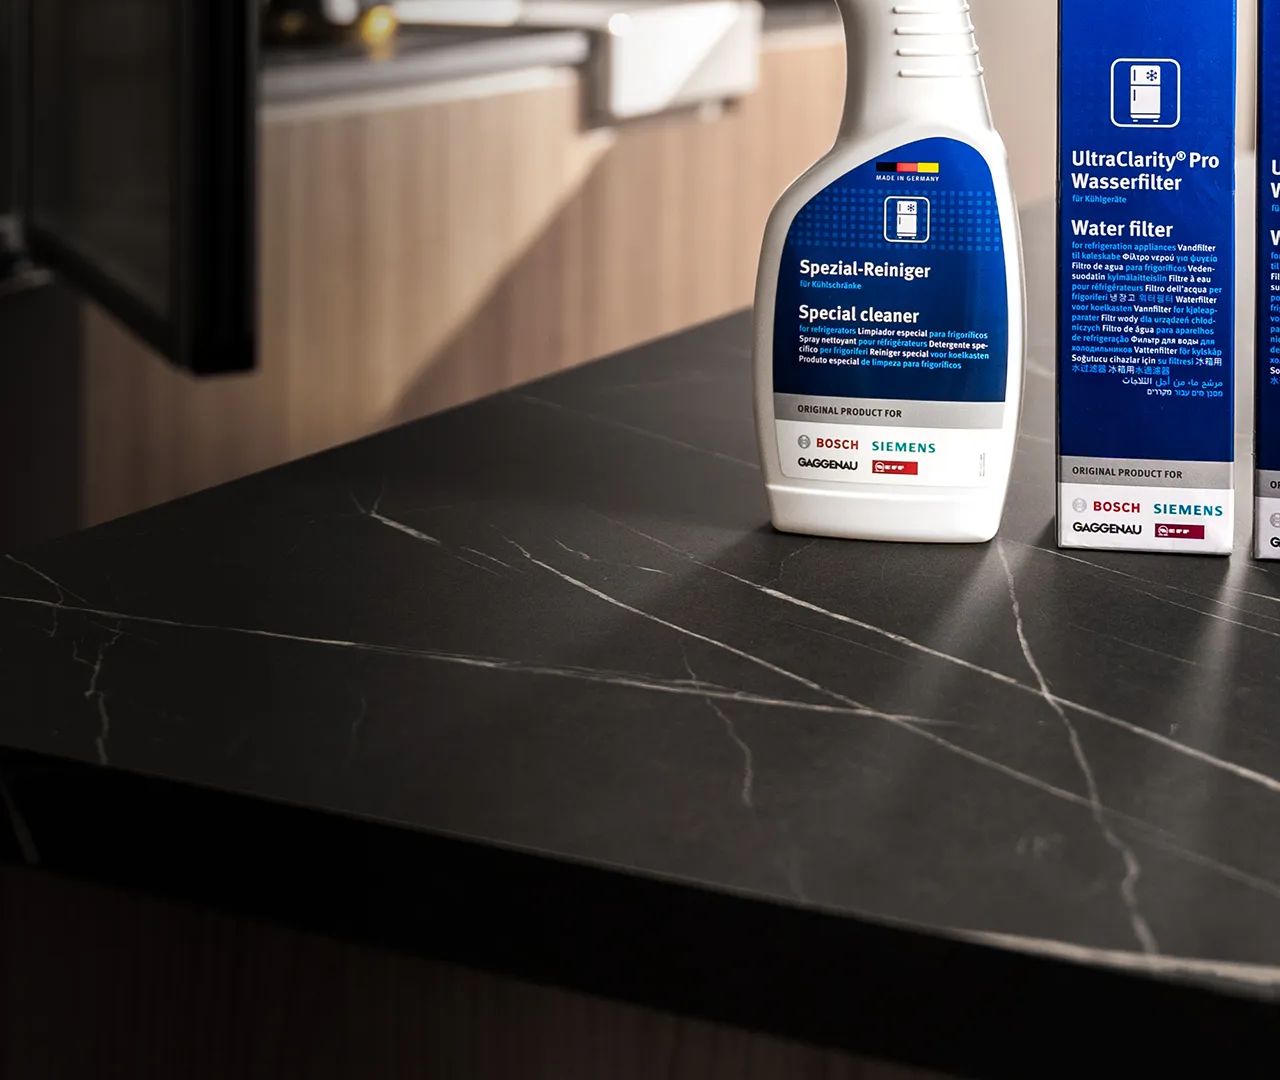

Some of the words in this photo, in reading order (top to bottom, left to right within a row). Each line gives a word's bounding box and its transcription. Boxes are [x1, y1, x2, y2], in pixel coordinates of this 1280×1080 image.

[1189, 151, 1219, 168] Pro
[1070, 172, 1182, 191] Wasserfilter
[1070, 219, 1125, 236] Water
[1129, 219, 1173, 238] filter
[799, 259, 931, 281] Spezial-Reiniger
[798, 304, 857, 323] Special
[859, 306, 920, 323] cleaner
[797, 404, 839, 415] ORIGINAL
[840, 407, 882, 417] PRODUCT
[884, 409, 902, 418] FOR
[816, 437, 858, 450] BOSCH
[871, 440, 935, 453] SIEMENS
[797, 456, 858, 471] GAGGENAU
[1071, 465, 1116, 476] ORIGINAL
[1118, 468, 1162, 478] PRODUCT
[1164, 470, 1182, 479] FOR
[1093, 500, 1140, 513] BOSCH
[1153, 503, 1223, 517] SIEMENS
[1072, 521, 1142, 535] GAGGENAU
